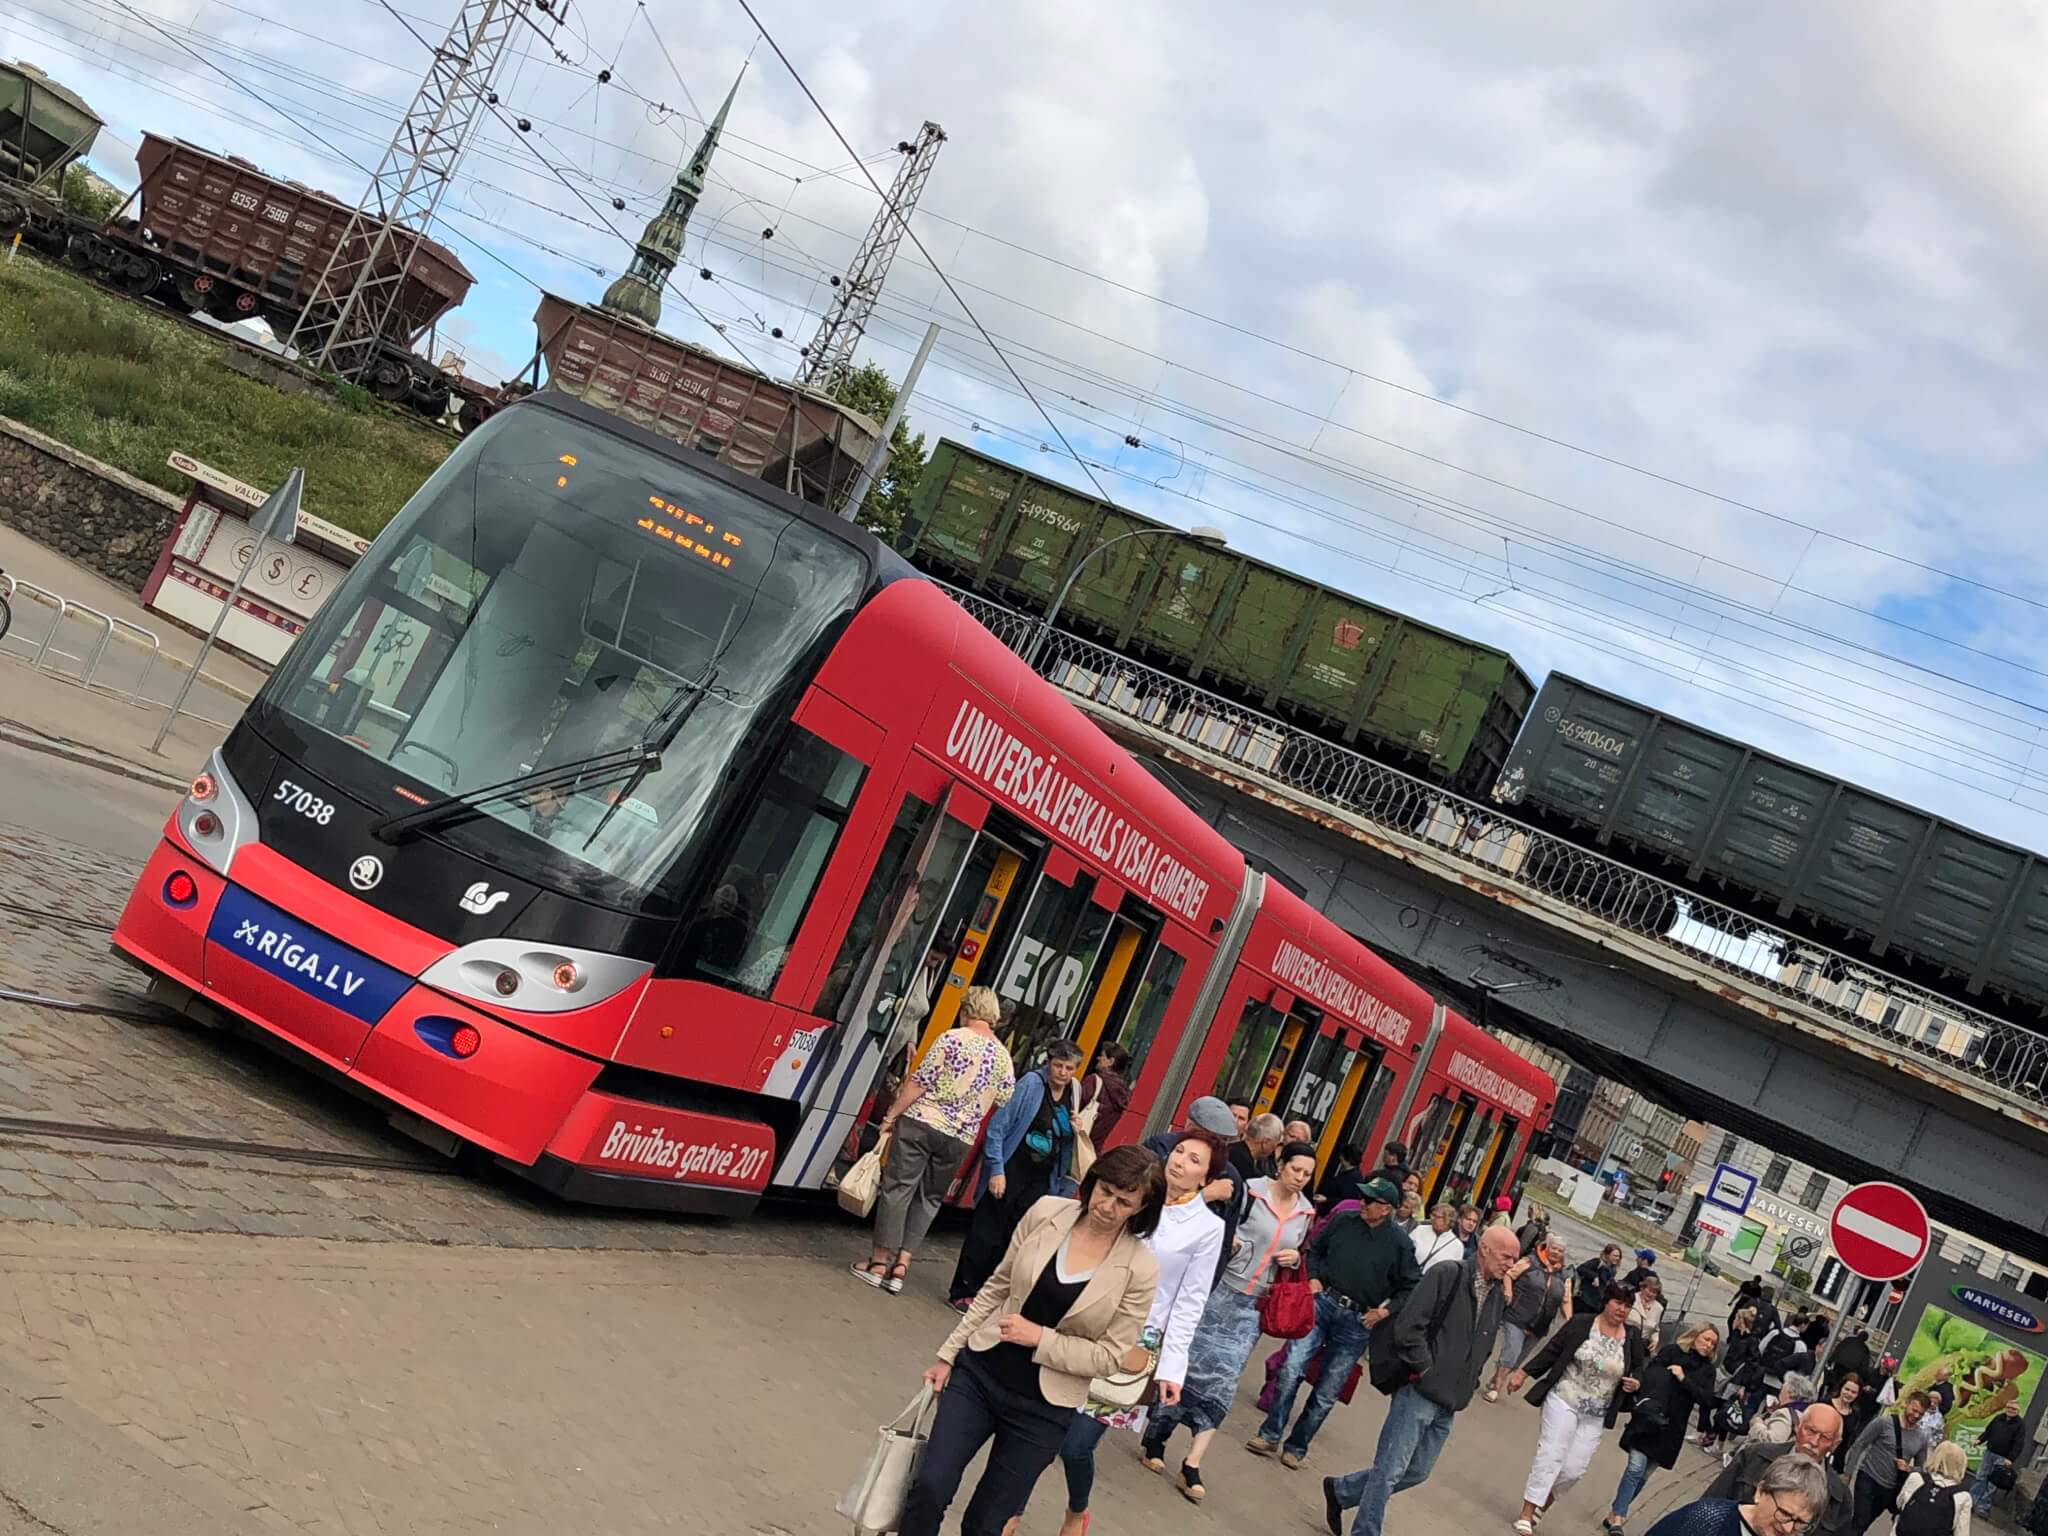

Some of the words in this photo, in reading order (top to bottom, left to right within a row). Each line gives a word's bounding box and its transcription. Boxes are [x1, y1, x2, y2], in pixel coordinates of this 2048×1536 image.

[230, 191, 259, 212] 9352
[1556, 719, 1625, 756] 56940604
[273, 780, 336, 825] 57038
[946, 700, 1124, 862] UNIVERSĀLVEIKALS
[1113, 823, 1160, 889] VISAI
[256, 929, 366, 997] RĪGA.LV
[789, 1030, 817, 1052] 57038
[600, 1121, 684, 1169] Brīvības
[674, 1140, 737, 1180] gatvē
[730, 1145, 769, 1180] 201
[1750, 1195, 1825, 1236] NARVESEN
[1964, 1291, 2031, 1327] NARVESEN
